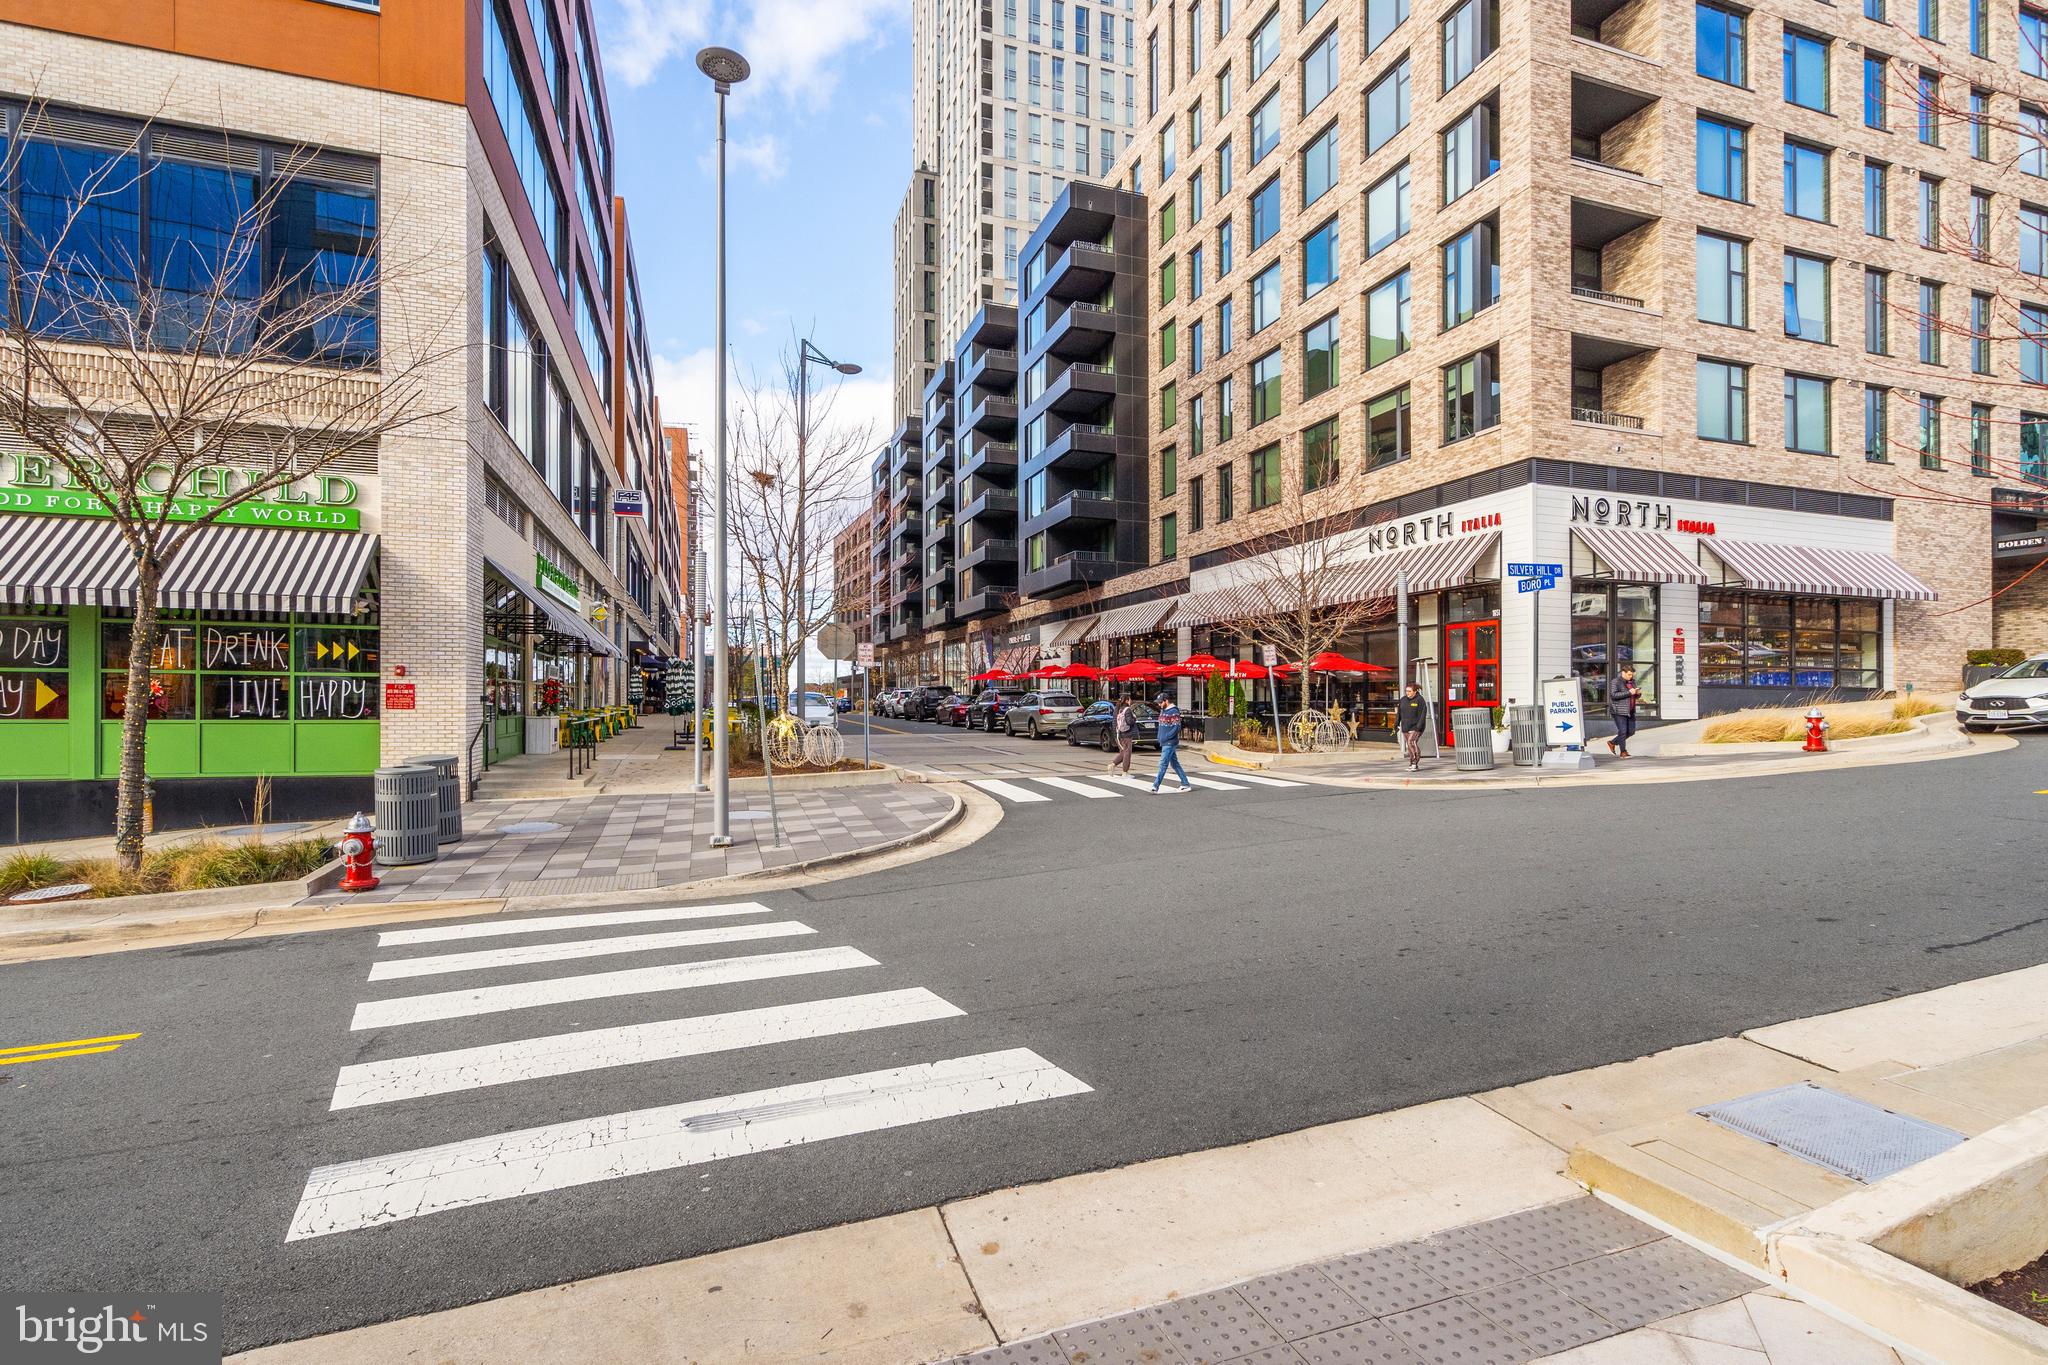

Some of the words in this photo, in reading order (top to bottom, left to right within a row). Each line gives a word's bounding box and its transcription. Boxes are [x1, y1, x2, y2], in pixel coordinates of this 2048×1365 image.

[137, 463, 358, 505] CHILD
[617, 491, 640, 501] F45
[46, 496, 103, 510] FOR
[251, 508, 346, 524] WORLD
[1571, 495, 1671, 530] NORTH
[1677, 519, 1715, 535] ITALIA
[1369, 512, 1455, 553] NORTH
[1461, 512, 1502, 533] ITALIA
[1510, 564, 1534, 575] SILVER
[1536, 565, 1552, 576] HILL
[1554, 567, 1562, 575] DR
[1521, 579, 1542, 591] BORO
[14, 627, 61, 665] DAY
[150, 628, 191, 669] AT,
[207, 627, 288, 670] DRINK,
[230, 677, 281, 718] LIVE
[301, 679, 366, 719] HAPPY
[1550, 707, 1577, 715] PARKING
